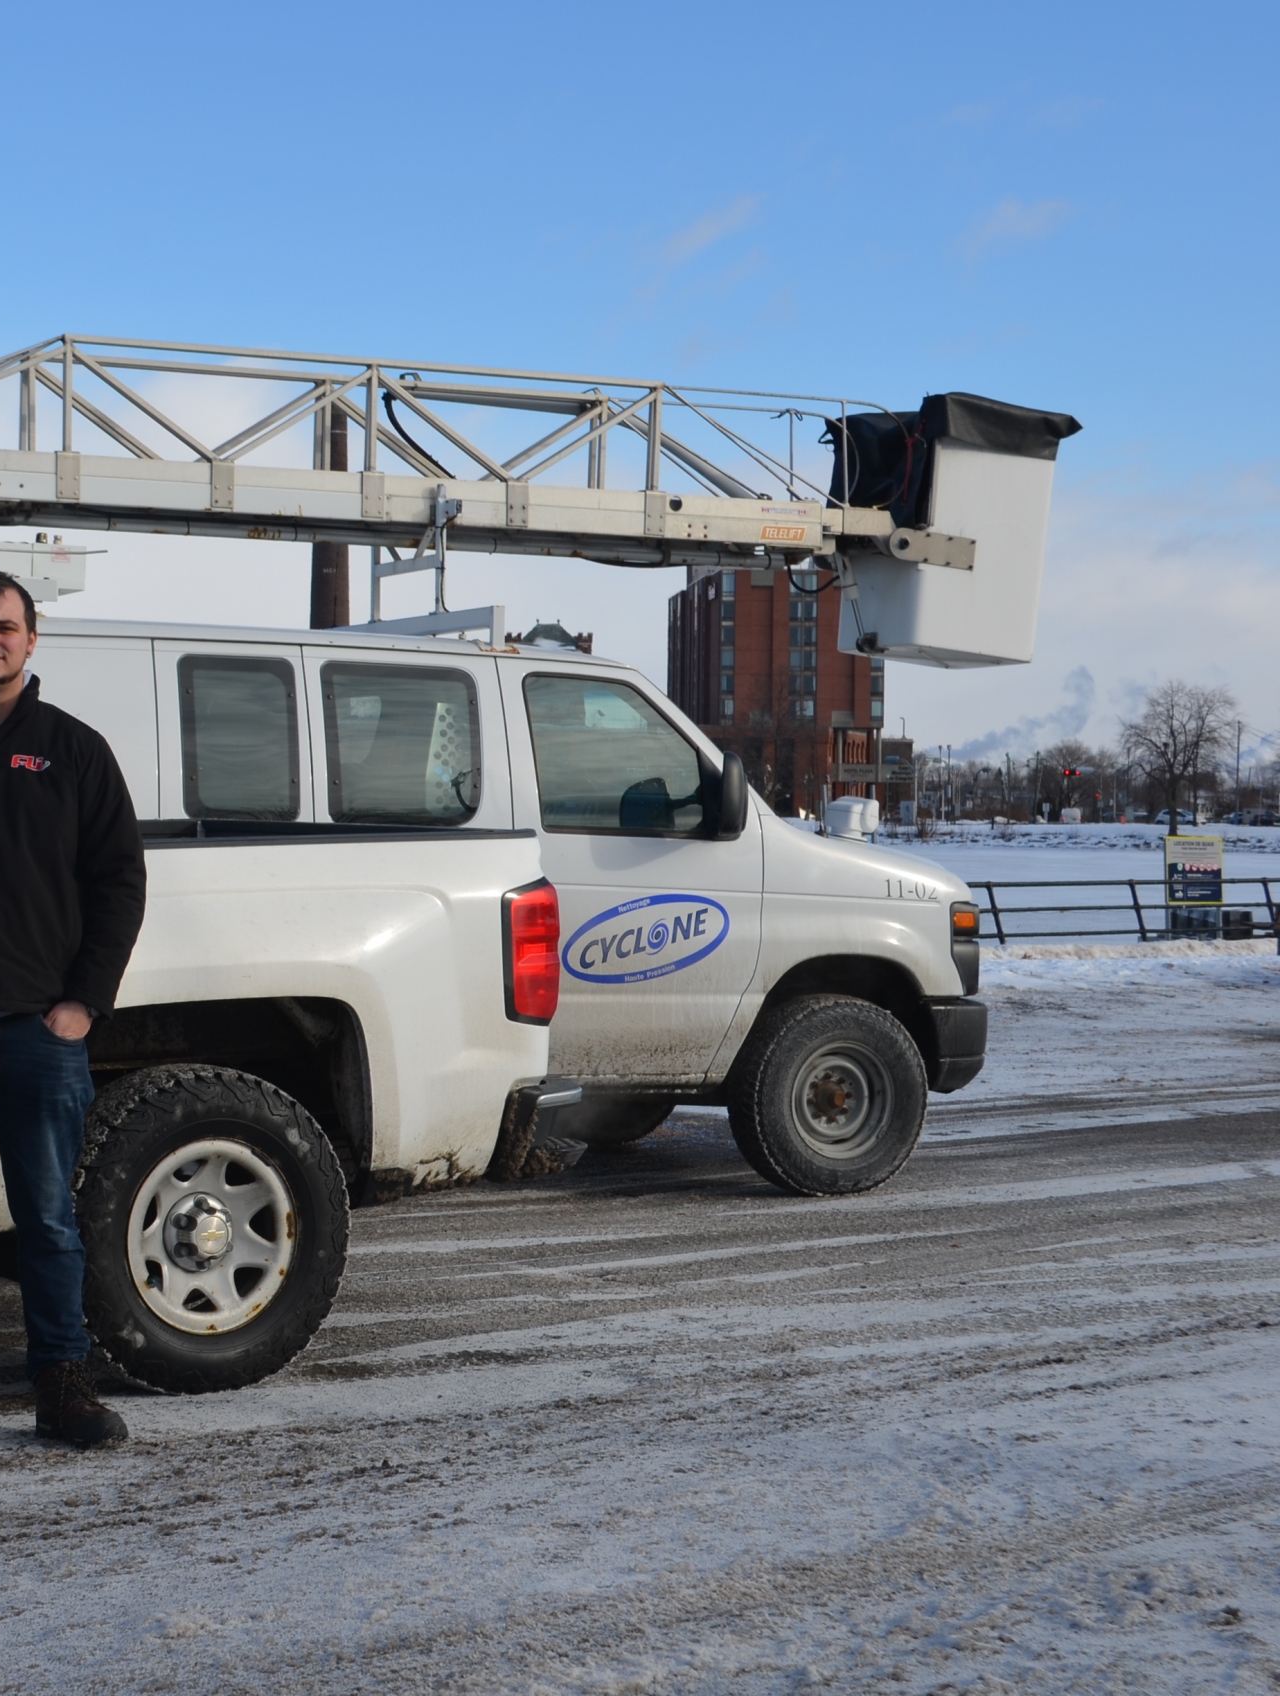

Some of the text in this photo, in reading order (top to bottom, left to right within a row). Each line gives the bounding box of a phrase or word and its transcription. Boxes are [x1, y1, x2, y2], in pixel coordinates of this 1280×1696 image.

[885, 879, 938, 900] 11-02
[618, 897, 651, 914] Nettoyage
[579, 908, 709, 970] CYCLONE
[624, 964, 676, 983] Haute Pression
